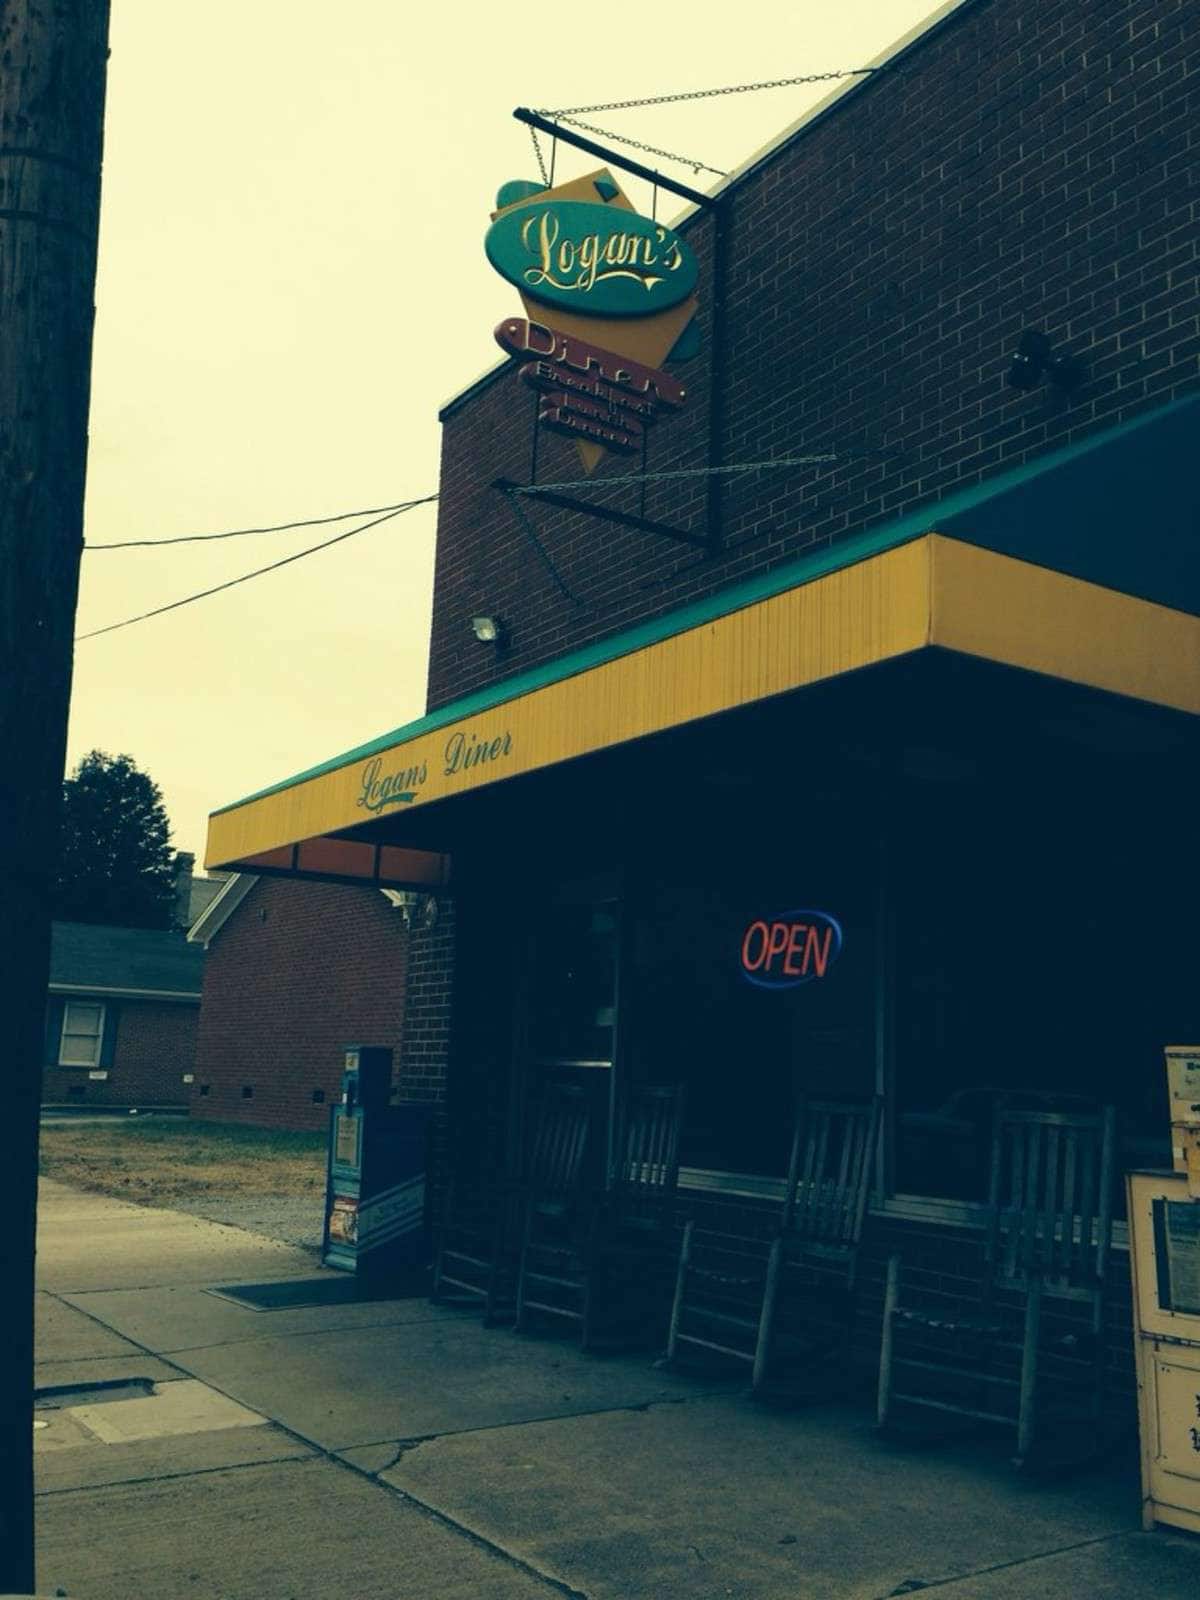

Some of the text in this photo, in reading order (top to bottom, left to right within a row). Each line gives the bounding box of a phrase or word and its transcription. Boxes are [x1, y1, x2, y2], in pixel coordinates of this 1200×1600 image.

[520, 210, 683, 292] Logan's
[525, 319, 663, 398] Diner
[356, 731, 512, 814] Logans Diner
[741, 920, 832, 978] OPEN
